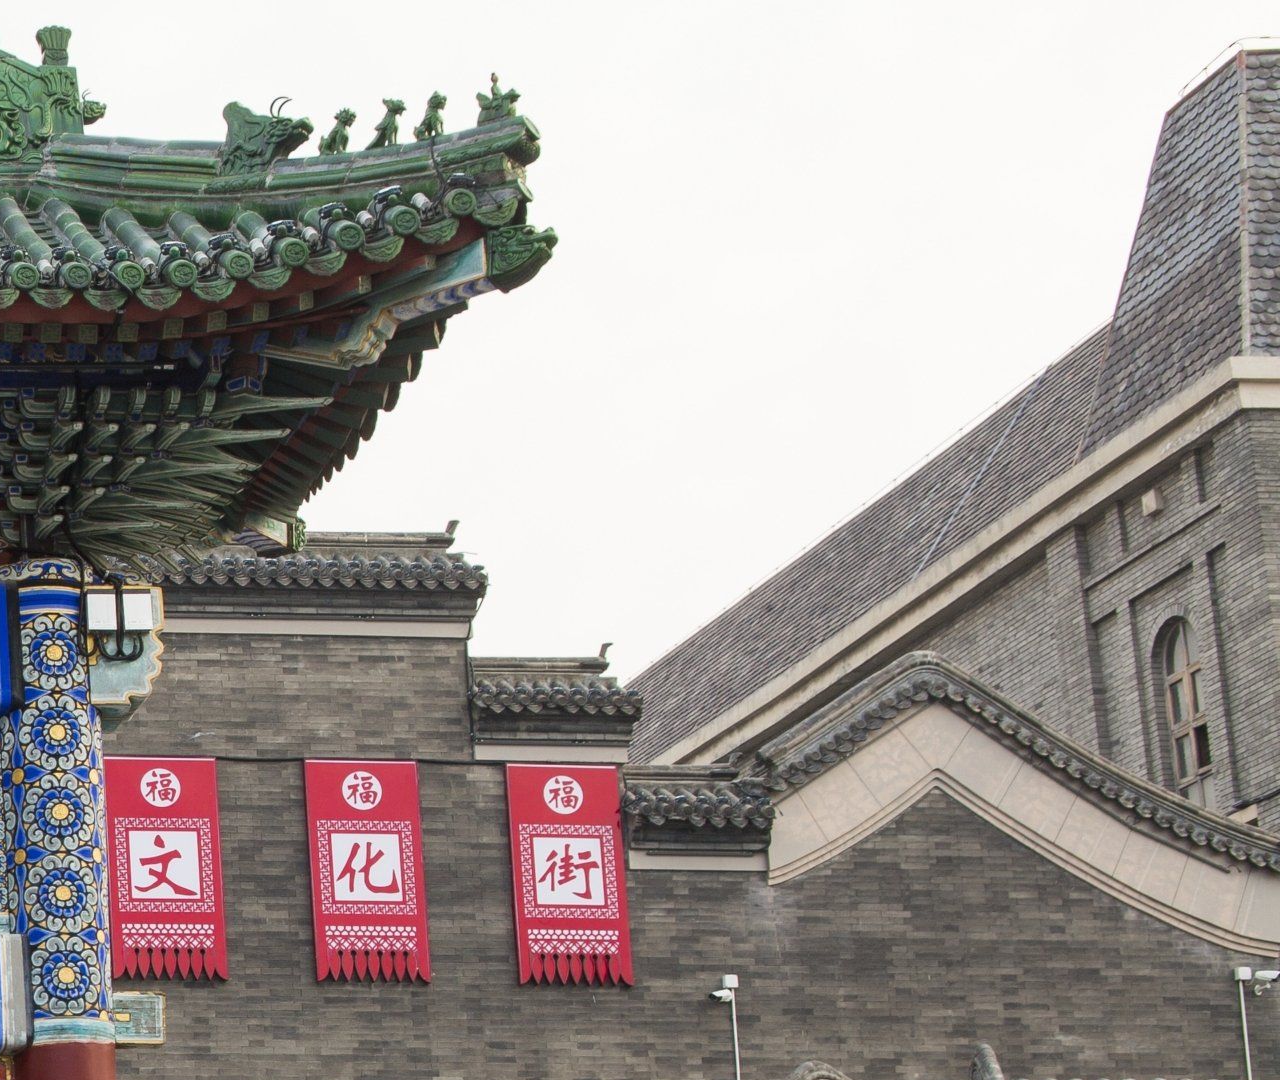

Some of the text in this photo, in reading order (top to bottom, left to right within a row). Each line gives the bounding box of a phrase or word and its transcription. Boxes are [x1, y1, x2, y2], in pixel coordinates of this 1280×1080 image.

[145, 771, 177, 803] 福
[346, 773, 378, 806] 福
[549, 779, 580, 811] 福
[134, 834, 199, 897] 文
[336, 841, 400, 895] 化
[538, 844, 600, 900] 街
